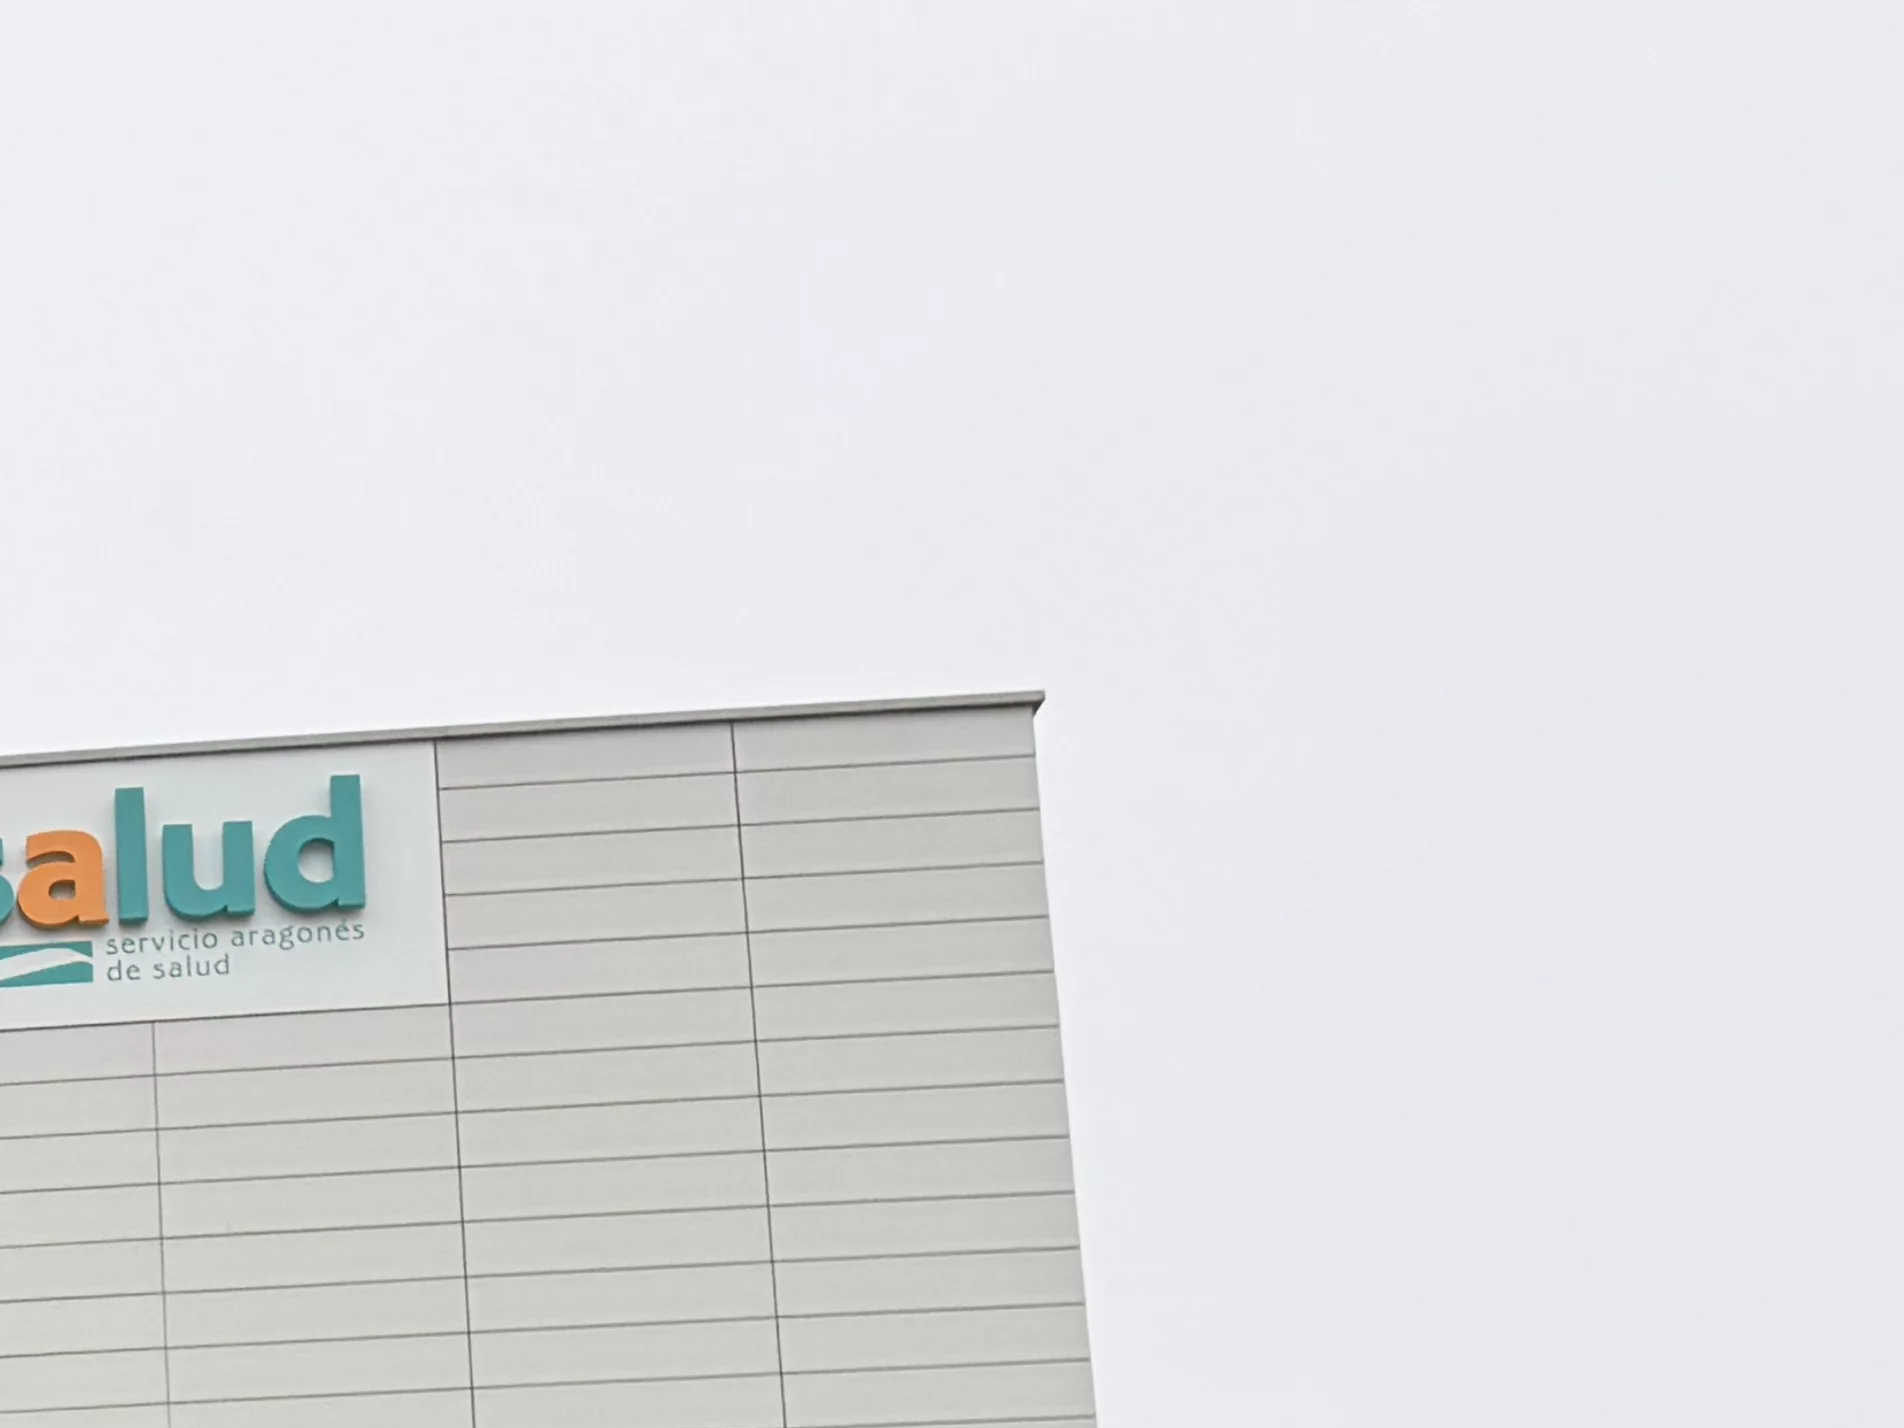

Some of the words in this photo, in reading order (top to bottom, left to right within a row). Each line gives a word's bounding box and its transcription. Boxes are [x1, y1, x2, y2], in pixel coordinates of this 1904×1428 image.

[105, 929, 218, 955] servicio
[231, 918, 366, 950] aragonés
[106, 959, 141, 981] de
[153, 953, 230, 979] salud
